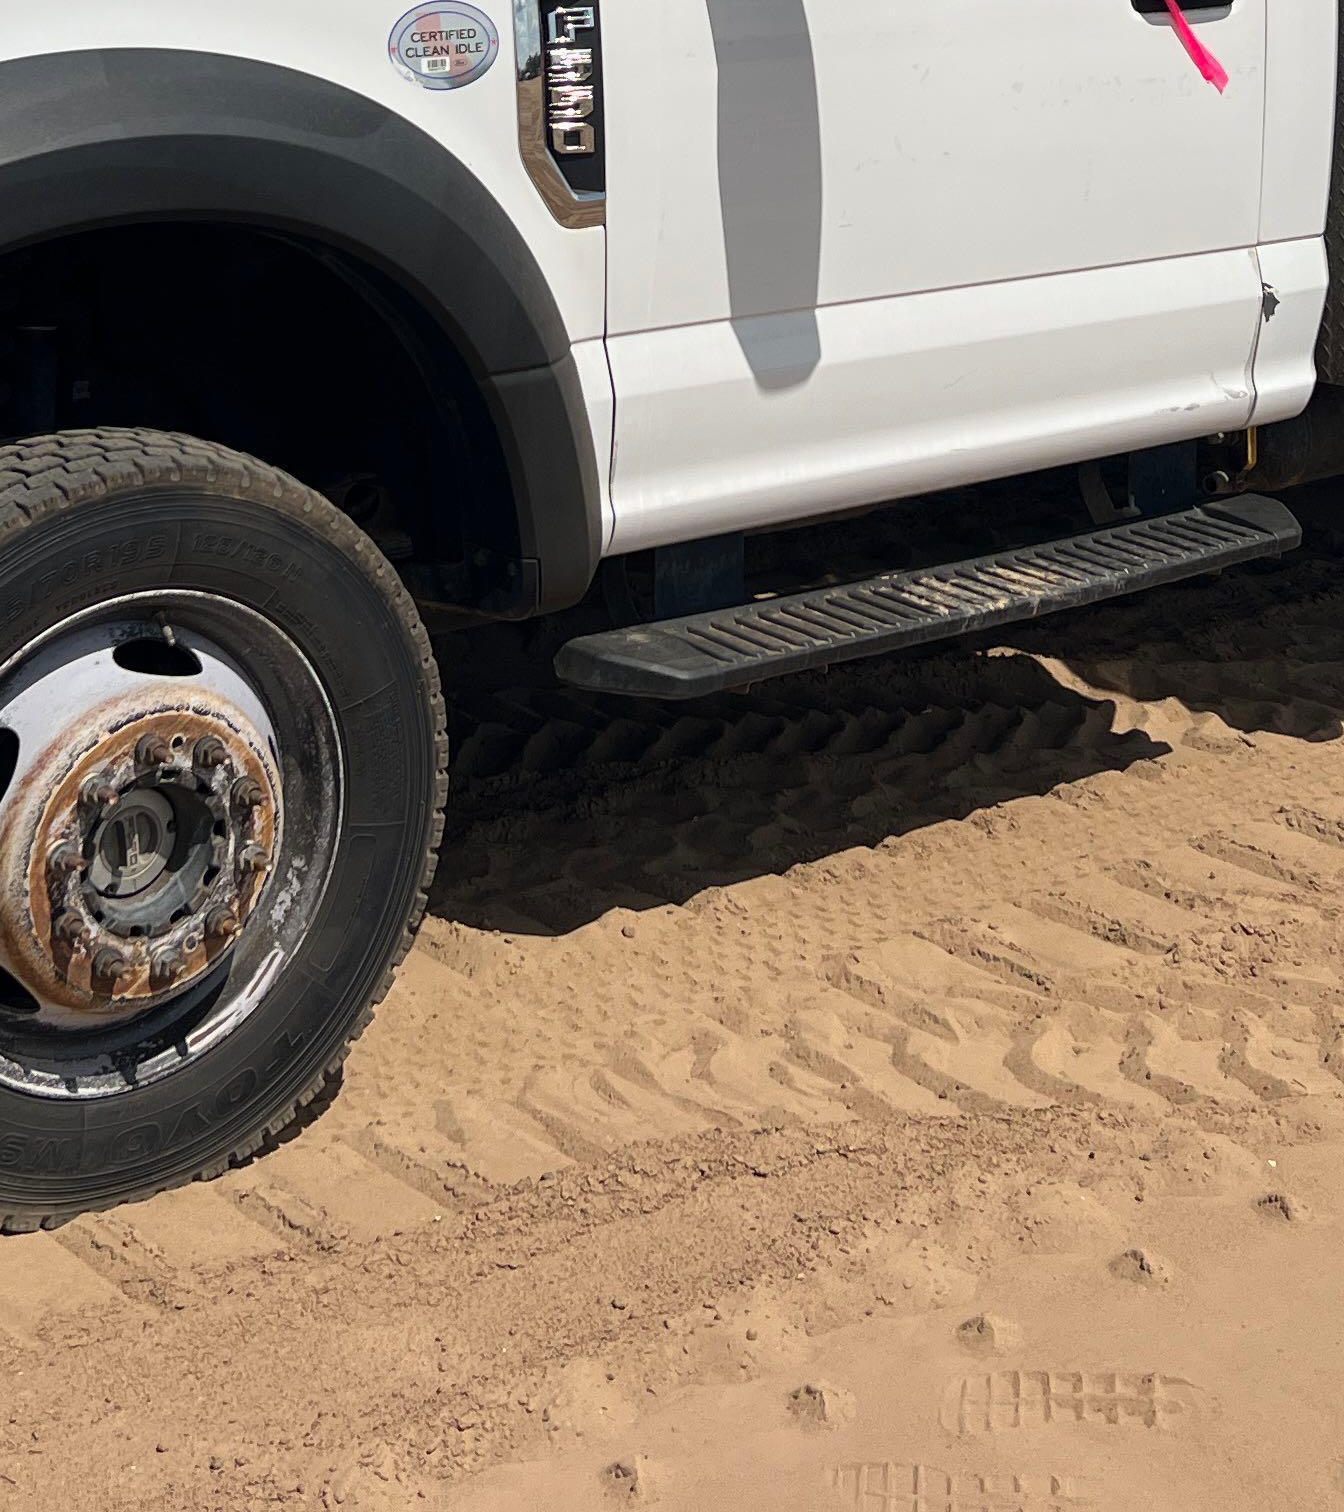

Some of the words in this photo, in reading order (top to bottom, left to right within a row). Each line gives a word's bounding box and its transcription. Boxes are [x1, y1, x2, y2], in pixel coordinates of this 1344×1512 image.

[410, 27, 477, 44] CERTIFIED
[405, 43, 450, 59] CLEAN
[455, 41, 484, 55] IDLE
